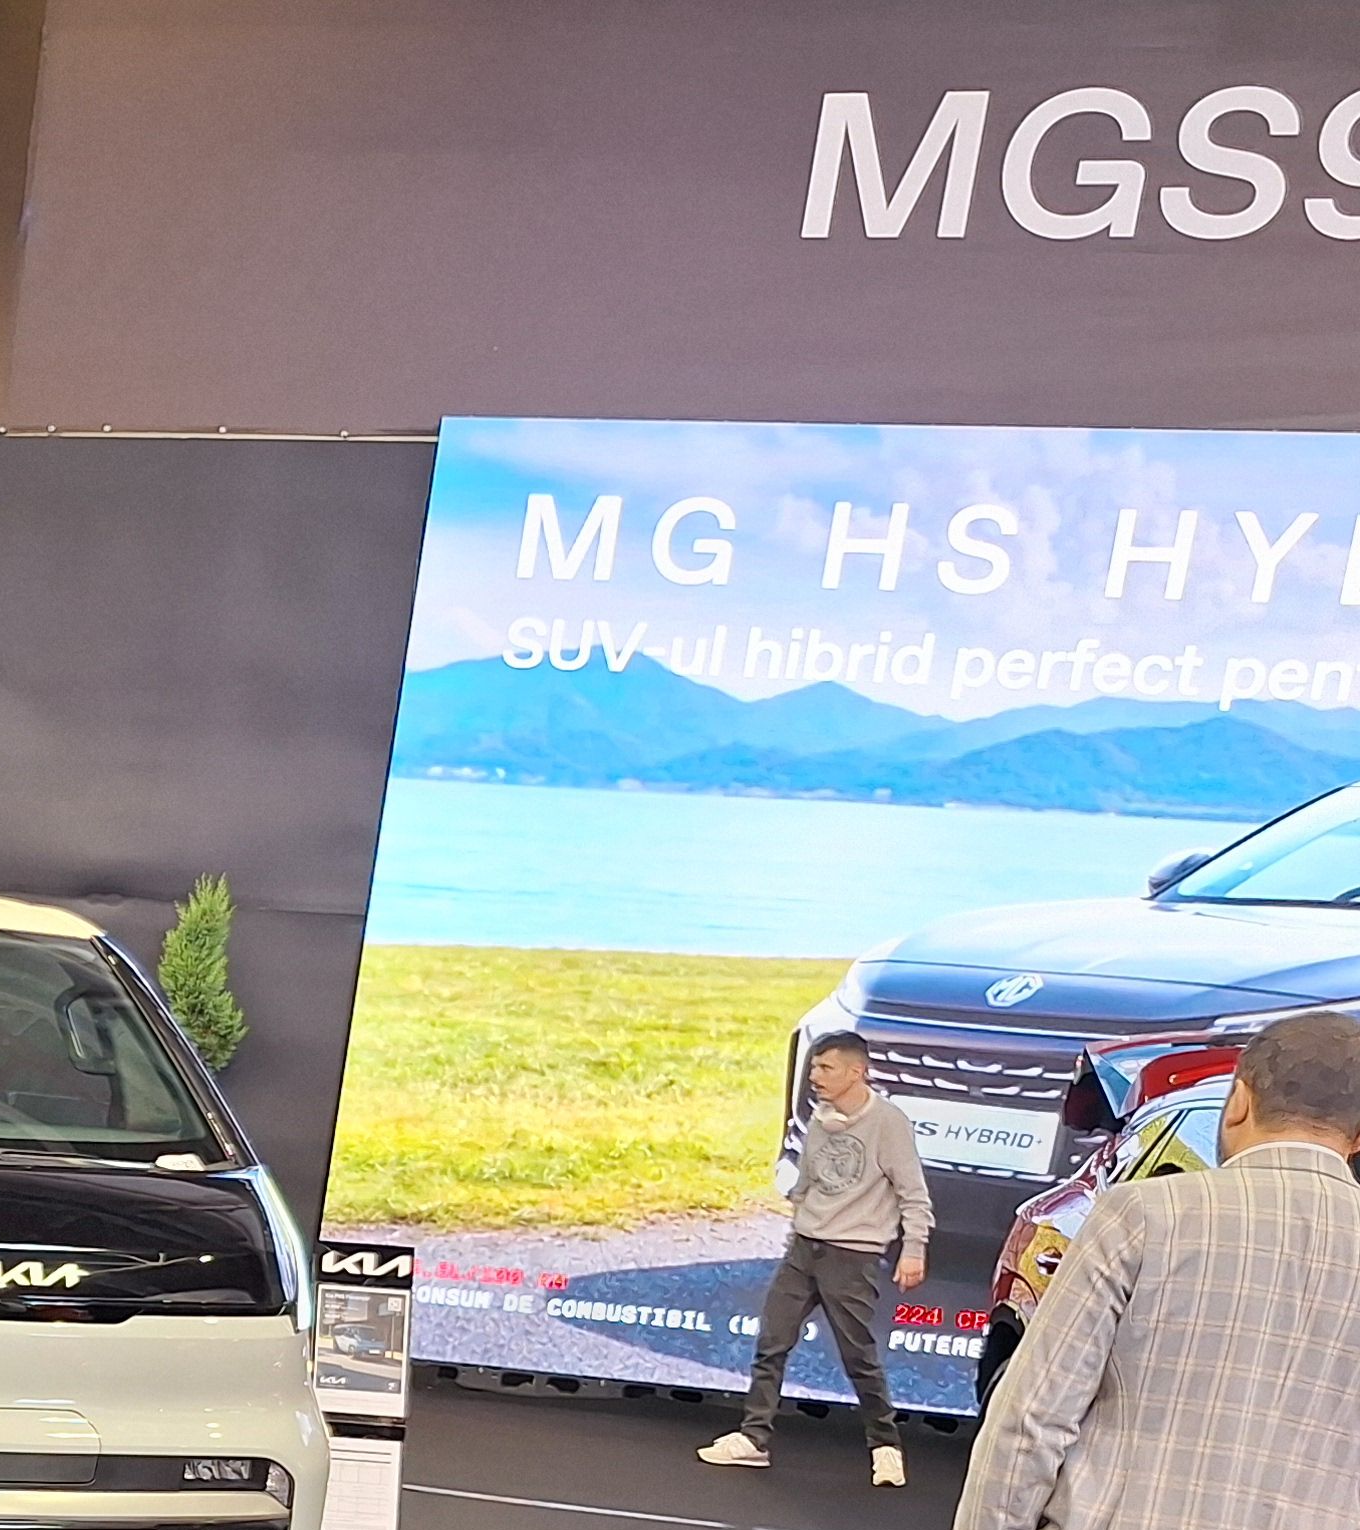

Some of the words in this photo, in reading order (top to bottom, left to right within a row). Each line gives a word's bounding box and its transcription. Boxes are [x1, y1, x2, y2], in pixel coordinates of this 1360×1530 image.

[514, 491, 737, 588] MG
[821, 501, 1019, 596] HS
[1102, 508, 1360, 606] HY
[500, 616, 729, 677] SUV-ul
[743, 624, 935, 686] hibrid
[949, 636, 1203, 701] perfect
[1218, 649, 1360, 712] pen
[910, 1121, 940, 1138] S
[321, 1250, 412, 1278] KIA
[412, 1286, 493, 1309] ONSUM
[503, 1294, 534, 1314] DE
[546, 1298, 712, 1332] COMBUSTIBIL
[892, 1303, 943, 1326] 224
[888, 1330, 985, 1360] PUTERE
